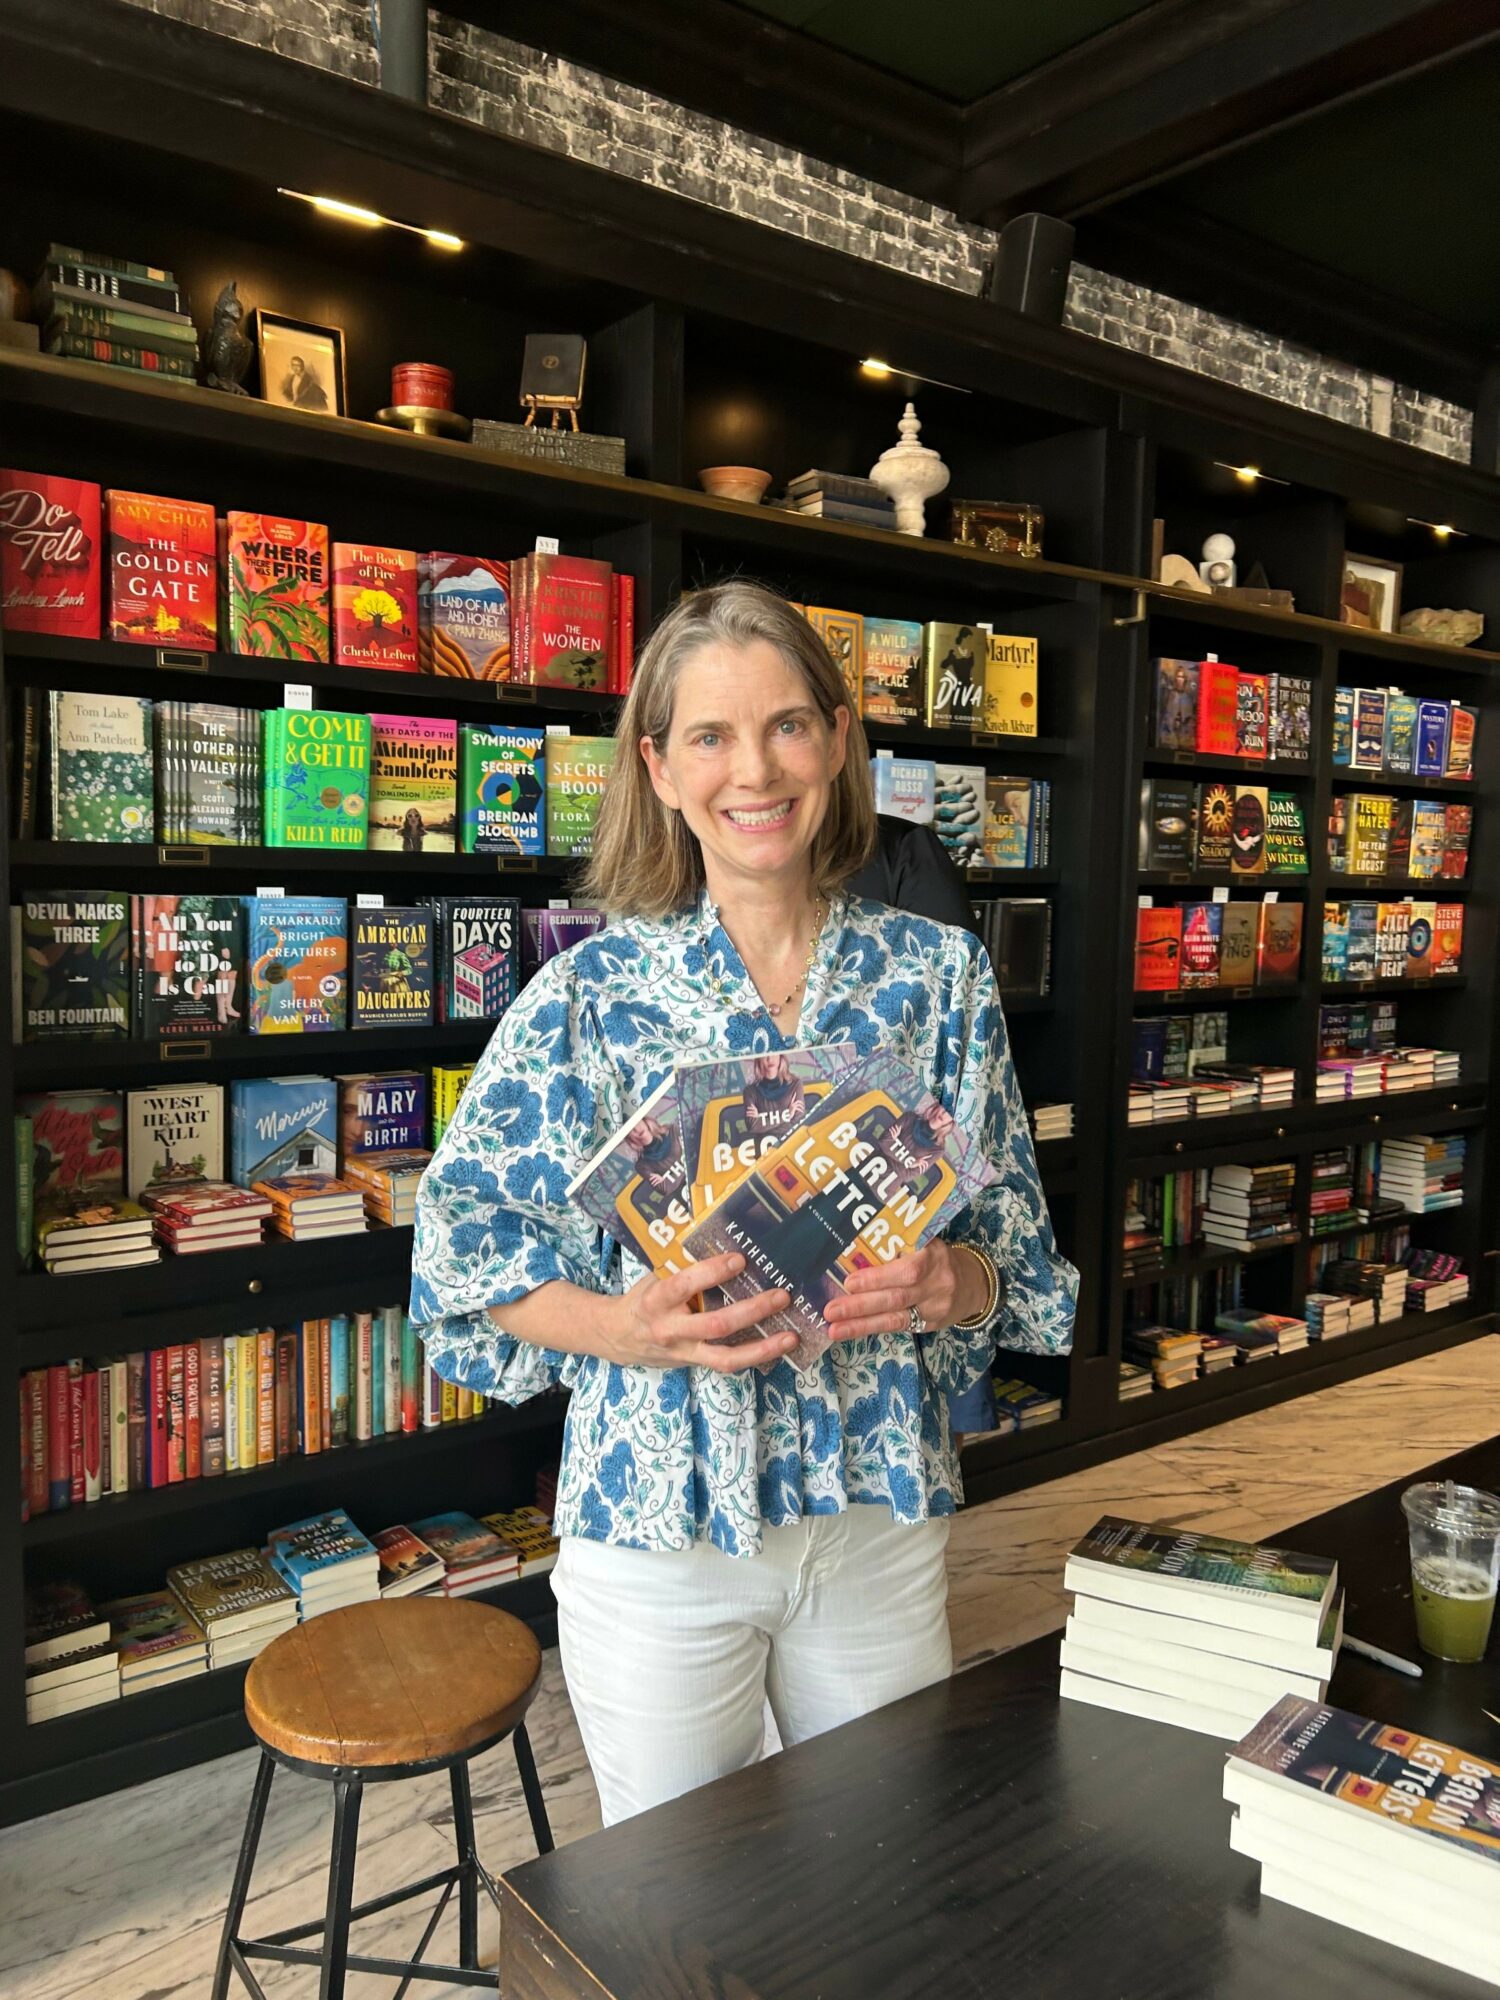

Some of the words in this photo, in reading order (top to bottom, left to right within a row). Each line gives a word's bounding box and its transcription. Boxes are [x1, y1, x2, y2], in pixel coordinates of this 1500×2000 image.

[0, 490, 72, 528] Do
[115, 504, 151, 520] AMY
[159, 511, 208, 528] CHUA
[11, 527, 83, 570] Tell
[148, 538, 178, 552] THE
[241, 541, 322, 567] WHERE
[352, 549, 374, 562] The
[376, 552, 404, 567] Book
[116, 552, 209, 577] GOLDEN
[246, 558, 271, 569] THERE
[255, 567, 271, 577] WAS
[273, 563, 322, 584] FIRE
[358, 566, 371, 578] of
[373, 568, 396, 580] Fire
[129, 577, 200, 602] GATE
[440, 594, 464, 610] LAND
[466, 598, 481, 612] OF
[483, 598, 507, 616] MILK
[447, 610, 466, 622] AND
[466, 612, 500, 626] HONEY
[564, 624, 582, 633] THE
[542, 632, 601, 651] WOMEN
[870, 633, 877, 645] A
[881, 634, 907, 649] WILD
[342, 645, 380, 660] Christy
[382, 648, 416, 662] Lefteri
[867, 651, 919, 669] HEAVENLY
[879, 673, 909, 688] PLACE
[73, 704, 100, 718] Tom
[103, 706, 130, 720] Lake
[201, 722, 226, 737] THE
[288, 714, 365, 743] COME
[408, 720, 420, 728] The
[1010, 720, 1034, 733] Akbar
[67, 731, 96, 743] Ann
[99, 733, 138, 746] Patchett
[374, 727, 394, 735] LAST
[398, 729, 420, 738] DAYS
[424, 730, 436, 738] OF
[438, 731, 454, 740] THE
[471, 733, 544, 750] SYMPHONY
[193, 740, 235, 756] OTHER
[285, 743, 300, 764] &
[300, 742, 345, 767] GET
[348, 745, 366, 769] IT
[373, 740, 454, 764] Midnight
[501, 751, 515, 760] OF
[190, 759, 237, 775] VALLEY
[372, 759, 457, 780] Ramblers
[481, 761, 535, 776] SECRETS
[890, 766, 929, 780] RICHARD
[376, 790, 420, 799] TOMLINSON
[894, 780, 923, 793] RUSSO
[202, 795, 225, 803] SCOTT
[1269, 801, 1294, 813] DAN
[1360, 801, 1391, 814] TERRY
[478, 810, 538, 823] BRENDAN
[553, 812, 591, 822] FLORA
[986, 815, 1015, 824] ALICE
[1268, 814, 1300, 828] JONES
[1359, 815, 1389, 829] HAYES
[286, 825, 325, 842] KILEY
[331, 826, 363, 843] REID
[477, 826, 538, 838] SLOCUMB
[1266, 834, 1304, 847] WOLVES
[1372, 842, 1386, 850] YEAR
[1267, 852, 1306, 865] WINTER
[1356, 860, 1384, 871] LOCUST
[27, 903, 71, 920] DEVIL
[75, 903, 125, 920] MAKES
[453, 908, 512, 920] FOURTEEN
[550, 915, 601, 925] BEAUTYLAND
[1437, 909, 1461, 919] STEVE
[157, 912, 187, 932] All
[191, 913, 233, 932] You
[260, 915, 343, 926] REMARKABLY
[1383, 915, 1410, 931] JACK
[1436, 920, 1461, 929] BERRY
[53, 926, 100, 944] THREE
[157, 932, 214, 952] Have
[279, 932, 325, 941] BRIGHT
[358, 924, 427, 944] AMERICAN
[453, 921, 512, 953] DAYS
[1381, 934, 1409, 952] CARR
[266, 947, 337, 957] CREATURES
[174, 960, 196, 973] to
[200, 953, 232, 972] Do
[159, 976, 179, 996] Is
[183, 976, 229, 995] Call
[280, 999, 325, 1009] SHELBY
[357, 990, 430, 1010] DAUGHTERS
[28, 1008, 55, 1025] BEN
[59, 1008, 125, 1024] FOUNTAIN
[273, 1015, 298, 1024] VAN
[304, 1013, 331, 1023] PELT
[144, 1095, 204, 1111] WEST
[357, 1089, 417, 1117] MARY
[143, 1110, 211, 1127] HEART
[255, 1098, 329, 1141] Mercury
[758, 1108, 791, 1127] THE
[154, 1127, 200, 1146] KILL
[364, 1126, 408, 1147] BIRTH
[889, 1138, 917, 1169] THE
[828, 1121, 927, 1228] BERLIN
[794, 1137, 906, 1262] LETTERS
[812, 1208, 824, 1223] COLD
[832, 1232, 845, 1246] NOVEL
[725, 1220, 794, 1293] KATHERINE
[794, 1295, 827, 1330] REAY
[362, 1322, 371, 1362] Shmutz
[171, 1350, 182, 1369] THE
[188, 1348, 199, 1375] GOOD
[210, 1362, 218, 1396] PEACH
[171, 1374, 184, 1426] WHISPERS
[188, 1378, 199, 1420] FORTUNE
[294, 1526, 341, 1544] ISLAND
[300, 1522, 323, 1534] THE
[300, 1536, 354, 1556] MISSING
[313, 1536, 330, 1544] OF
[312, 1546, 352, 1560] TREES
[1158, 1533, 1203, 1573] MOSCOW
[176, 1553, 256, 1579] LEARNED
[181, 1575, 205, 1588] BY
[214, 1560, 263, 1580] HEART
[204, 1586, 289, 1617] DONOGHUE
[219, 1585, 263, 1602] EMMA
[1298, 1710, 1334, 1750] KATHERINE
[1276, 1745, 1301, 1769] REAY
[1381, 1743, 1455, 1819] LETTERS
[1428, 1760, 1492, 1832] BERLIN
